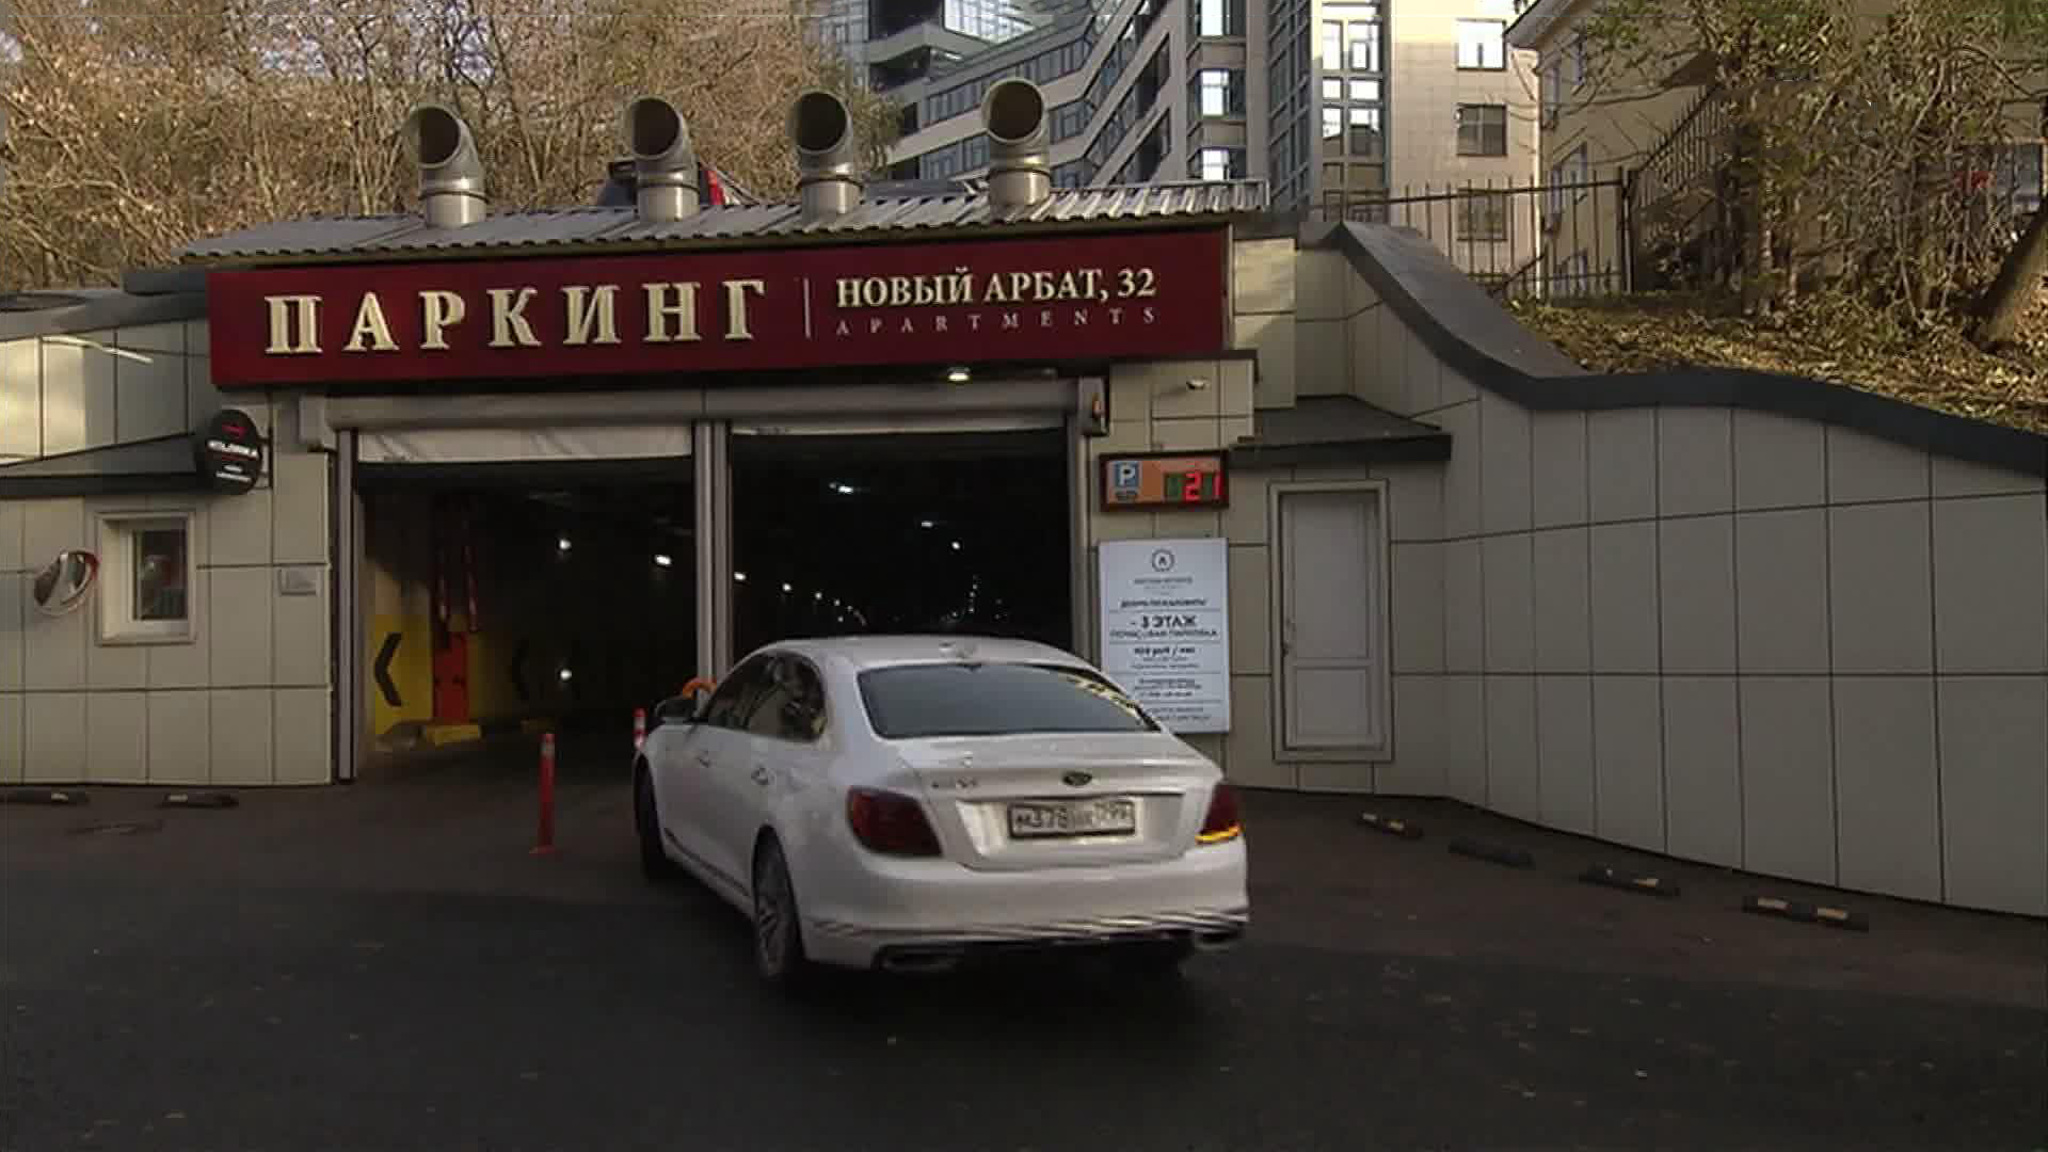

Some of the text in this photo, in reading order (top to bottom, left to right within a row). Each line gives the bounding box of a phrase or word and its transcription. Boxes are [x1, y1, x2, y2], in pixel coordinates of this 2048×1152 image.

[836, 266, 1157, 308] НОВЫЙ АРБАТ, 32
[264, 279, 766, 354] ПАРКИНГ
[836, 307, 1156, 336] APARTMENTS
[1184, 470, 1221, 501] 21
[1151, 615, 1197, 628] ЭТАЖ
